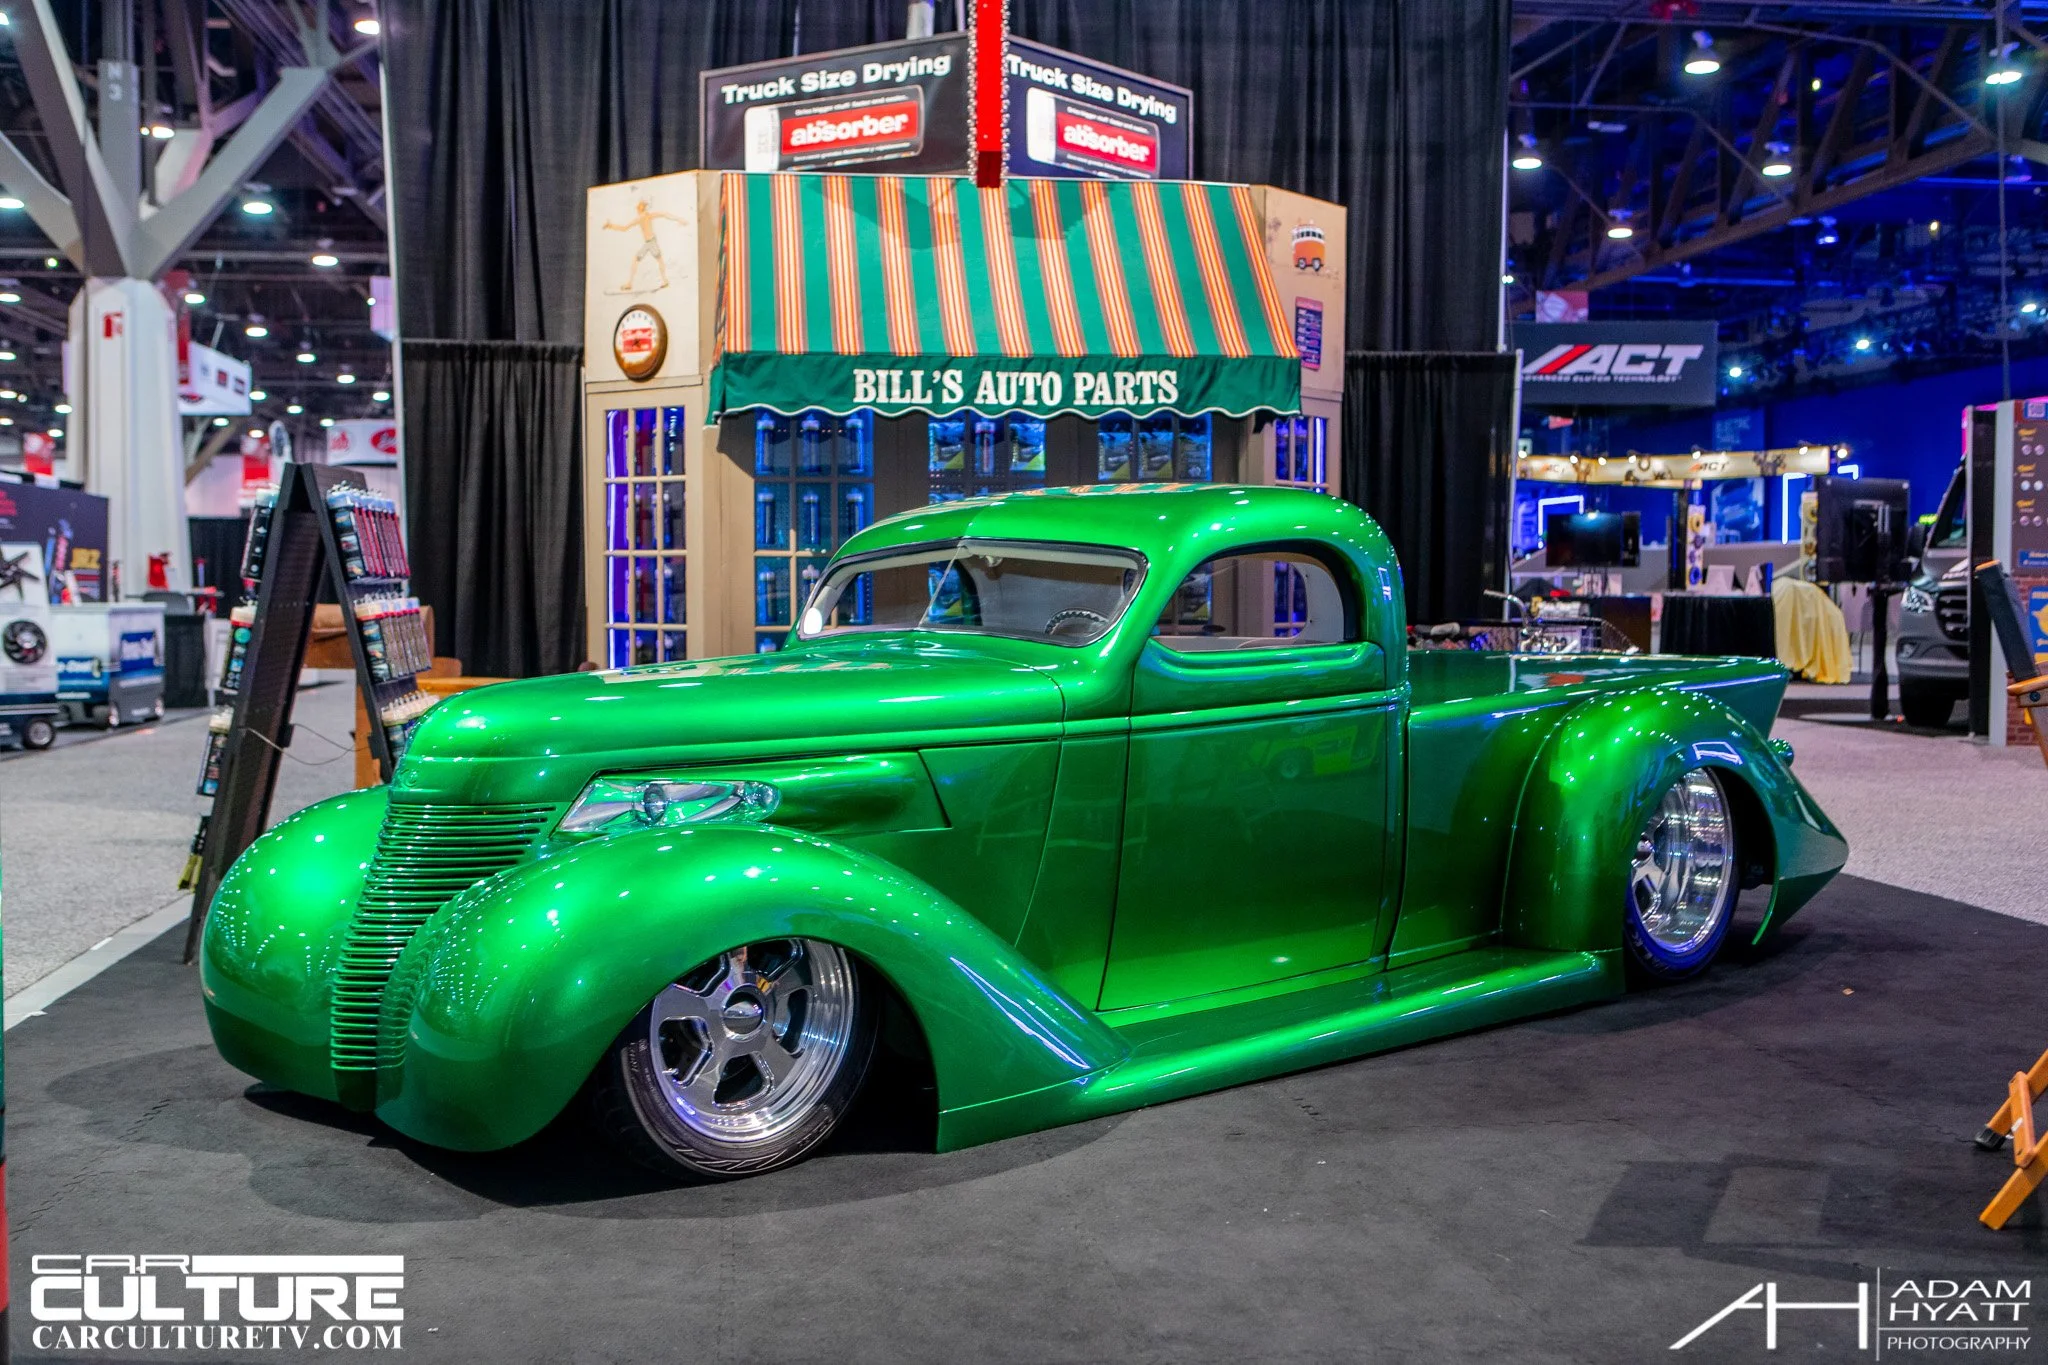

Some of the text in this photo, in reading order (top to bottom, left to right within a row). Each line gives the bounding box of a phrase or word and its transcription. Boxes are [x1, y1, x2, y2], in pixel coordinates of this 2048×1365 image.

[721, 55, 951, 103] Truck Size Drying
[1008, 55, 1068, 90] Truck
[1071, 73, 1113, 102] Size
[1117, 87, 1177, 124] Drying
[790, 113, 909, 146] absorber
[1064, 123, 1149, 162] absorber
[1522, 344, 1703, 374] ACT
[852, 368, 1179, 406] BILL'S AUTO PARTS
